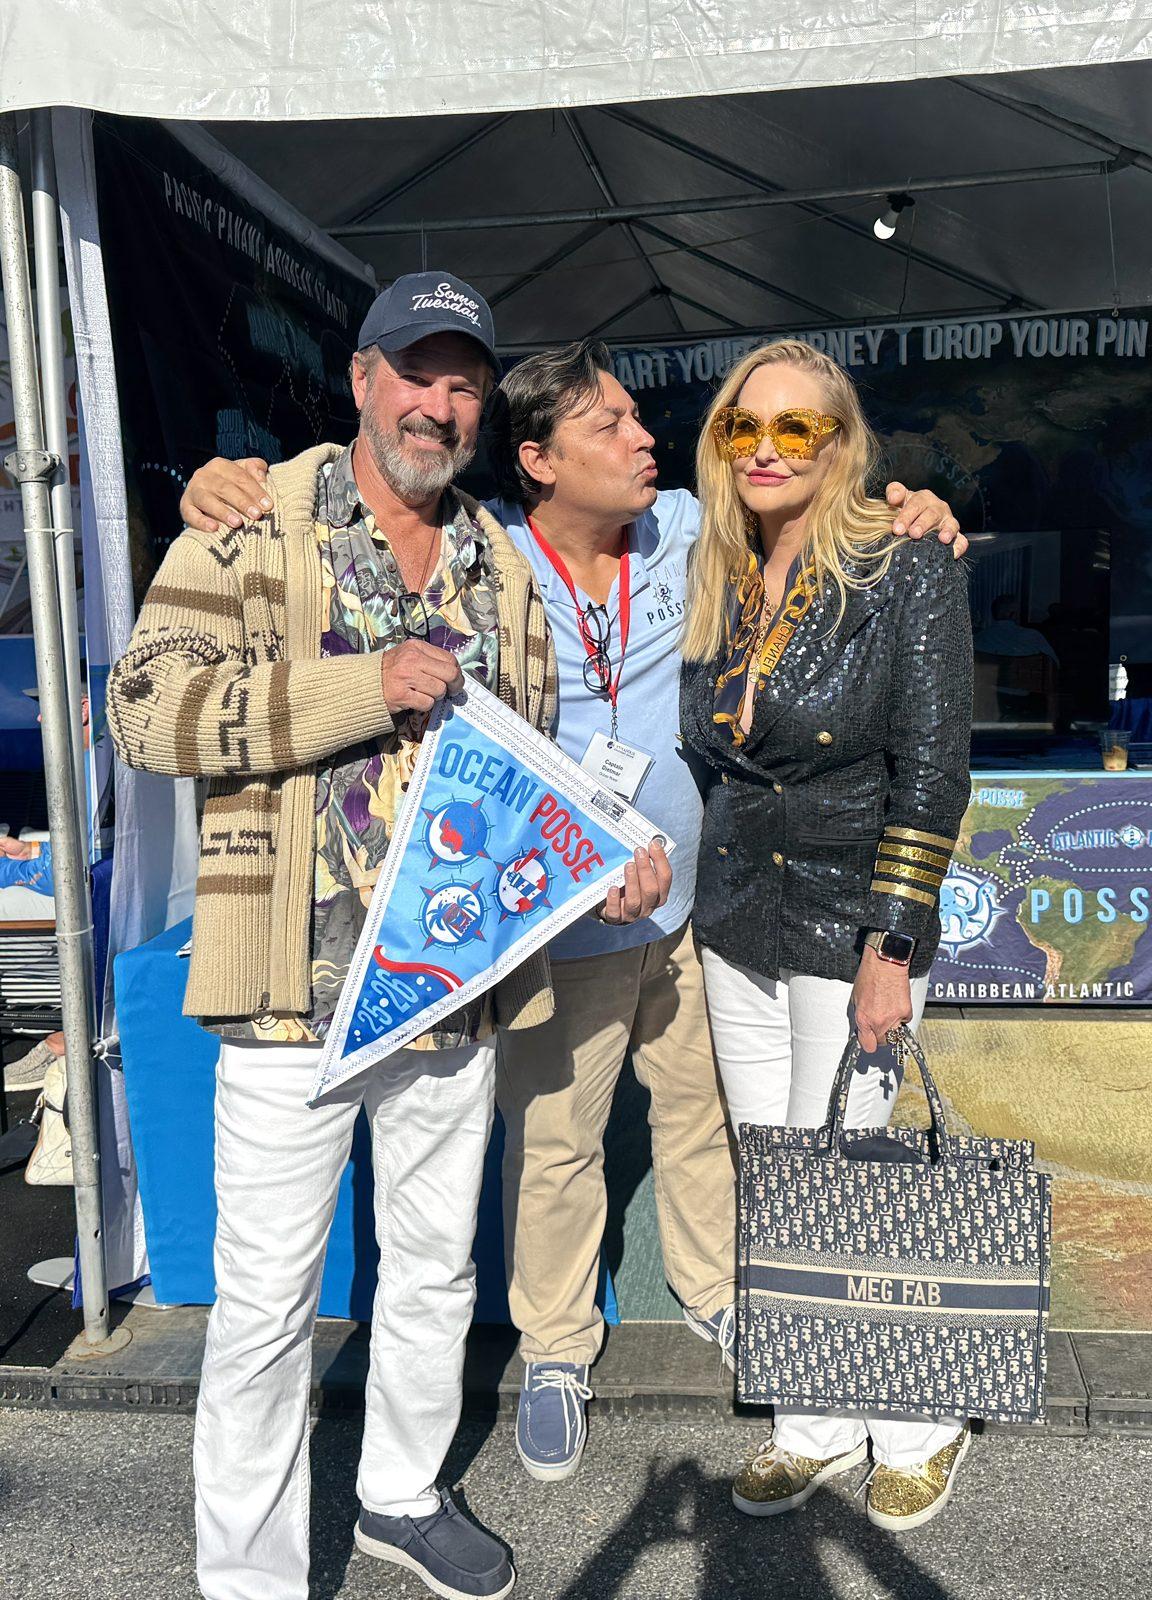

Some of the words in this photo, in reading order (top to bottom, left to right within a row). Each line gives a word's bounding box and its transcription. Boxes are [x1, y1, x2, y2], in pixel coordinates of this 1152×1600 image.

[409, 293, 482, 328] Tuesday
[434, 282, 479, 310] Some
[610, 351, 669, 391] ART
[791, 329, 885, 367] RNEY
[922, 321, 1003, 361] DROP
[1009, 318, 1090, 358] YOUR
[1095, 317, 1149, 358] PIN
[438, 743, 538, 814] OCEAN
[528, 792, 605, 883] POSSE
[1052, 829, 1118, 852] ATLANTIC
[934, 982, 1035, 999] CARIBBEAN
[1046, 981, 1135, 998] ATLANTIC
[847, 1275, 893, 1303] MEG
[902, 1280, 942, 1306] FAB
